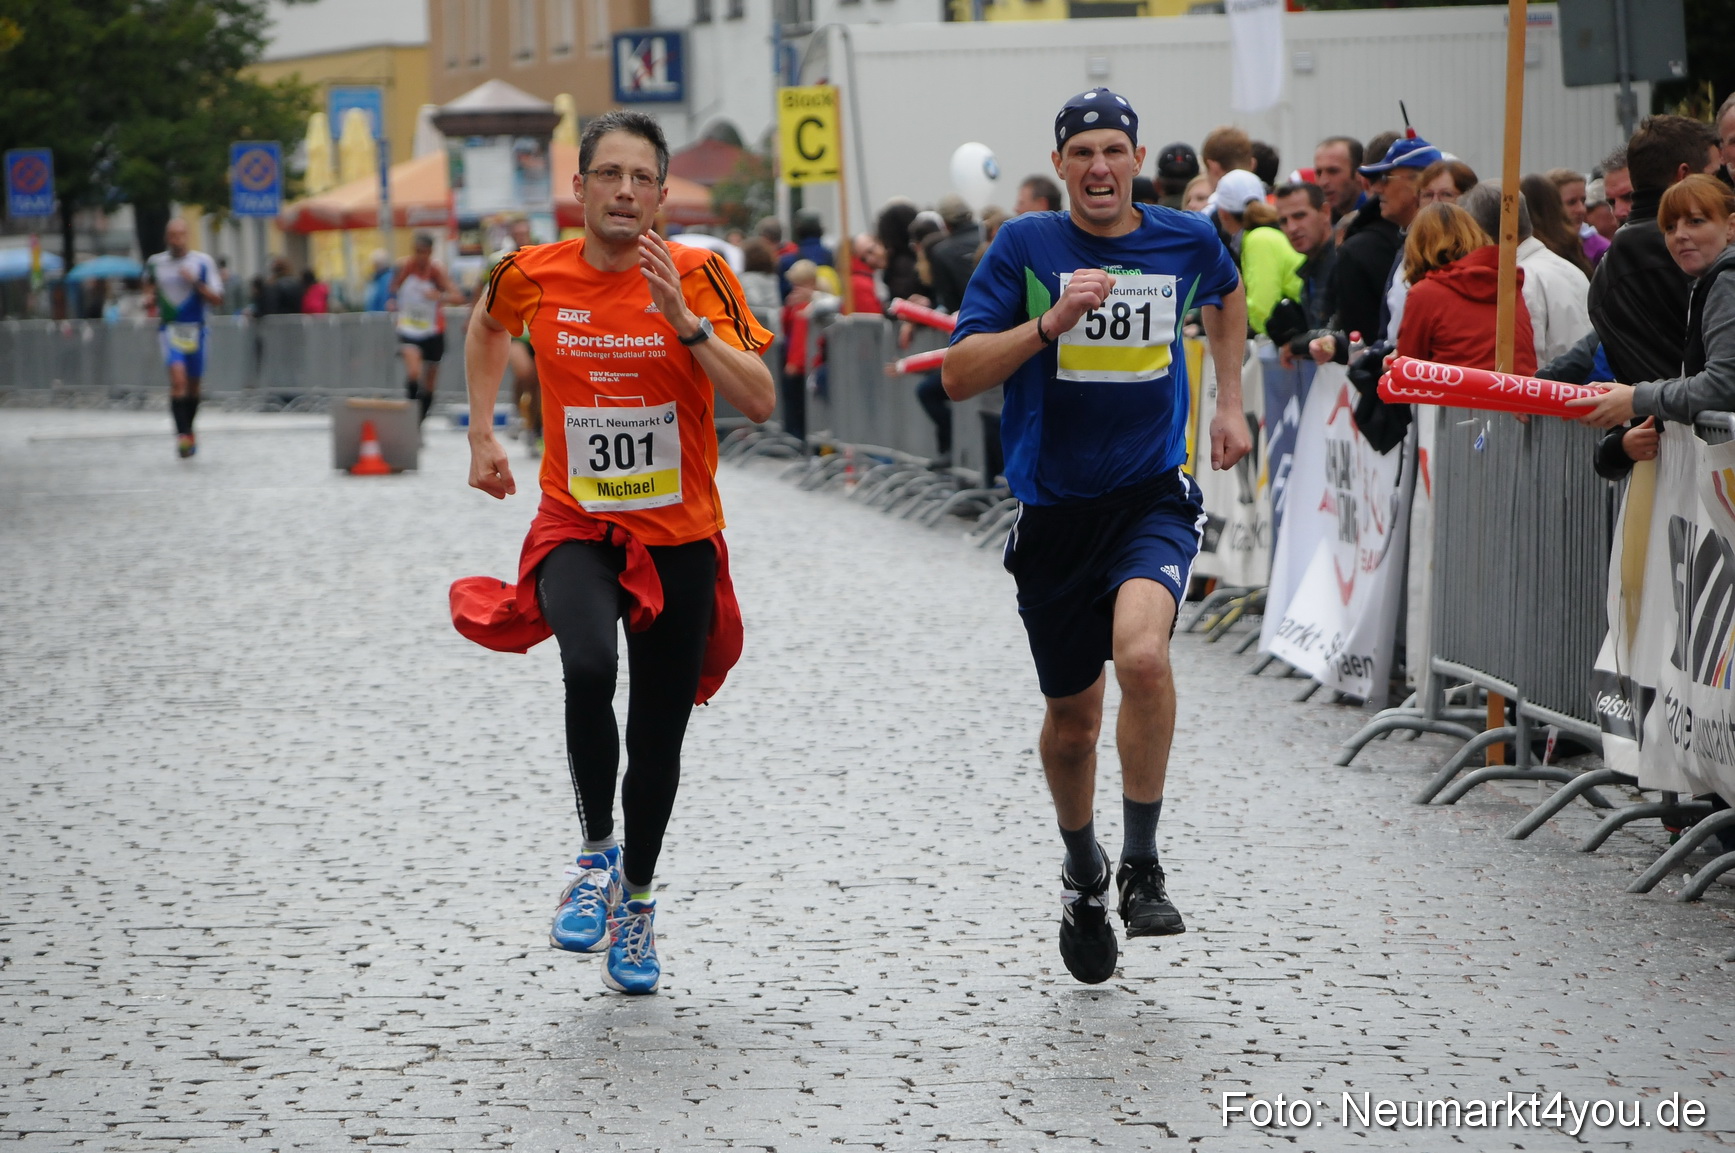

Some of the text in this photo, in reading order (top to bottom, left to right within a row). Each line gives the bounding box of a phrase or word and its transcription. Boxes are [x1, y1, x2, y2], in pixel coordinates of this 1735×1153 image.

[795, 117, 825, 161] C
[557, 308, 591, 324] DAK
[1085, 302, 1151, 341] 581
[557, 331, 665, 348] SportScheck
[556, 347, 666, 360] 15. Nürnberger Stadtlauf 2010
[1488, 373, 1541, 397] BKK
[566, 416, 660, 429] PARTL Neumarkt
[588, 431, 655, 472] 301
[597, 478, 656, 497] Michael
